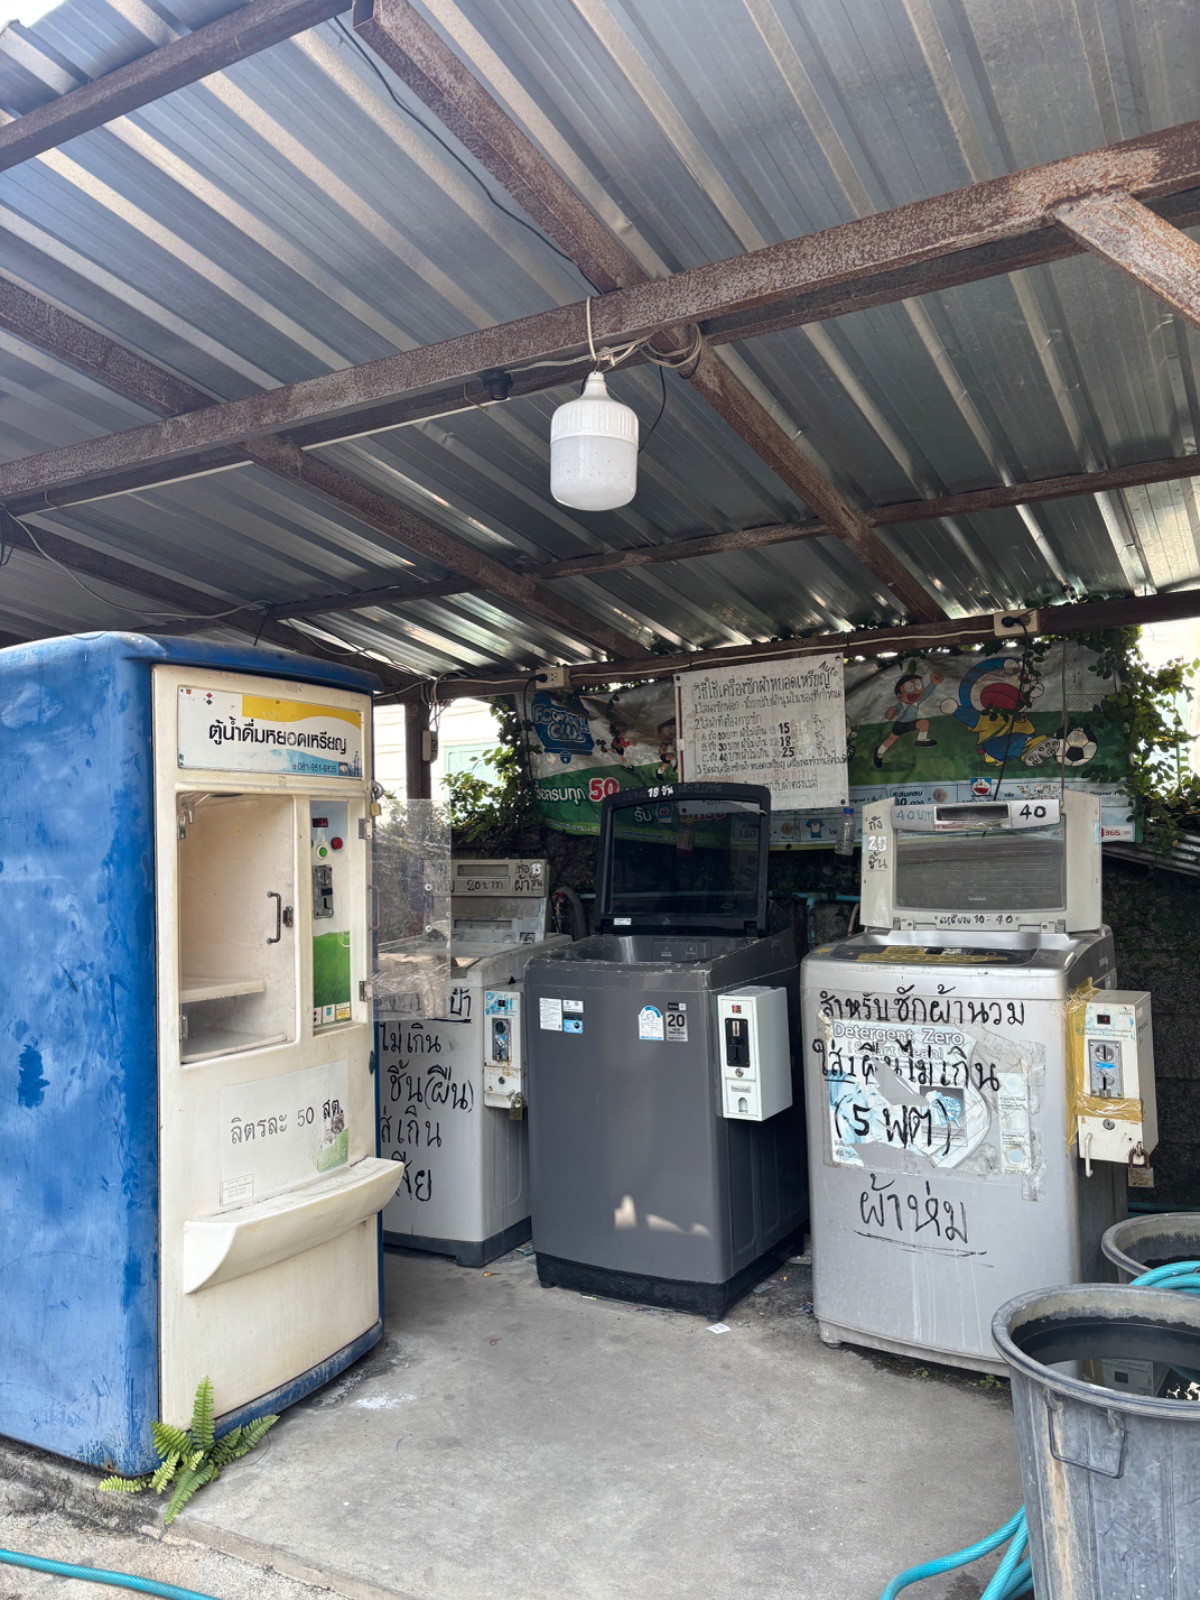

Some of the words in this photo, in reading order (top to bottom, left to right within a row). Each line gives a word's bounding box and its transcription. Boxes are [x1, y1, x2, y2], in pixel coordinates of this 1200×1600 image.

[208, 716, 347, 755] ตู้น้ำดื่มหยอดเหรียญ
[778, 722, 790, 734] 15
[779, 735, 791, 747] 18
[781, 745, 795, 758] 25
[589, 777, 619, 801] 50
[1019, 803, 1047, 821] 40
[667, 1013, 686, 1028] 20
[833, 1022, 914, 1044] Detergent
[922, 1028, 965, 1046] Zero
[854, 1041, 896, 1056] Sart
[230, 1114, 288, 1145] ลิตรละ
[297, 1106, 315, 1128] 50
[859, 1173, 969, 1245] ผ้าห่ม
